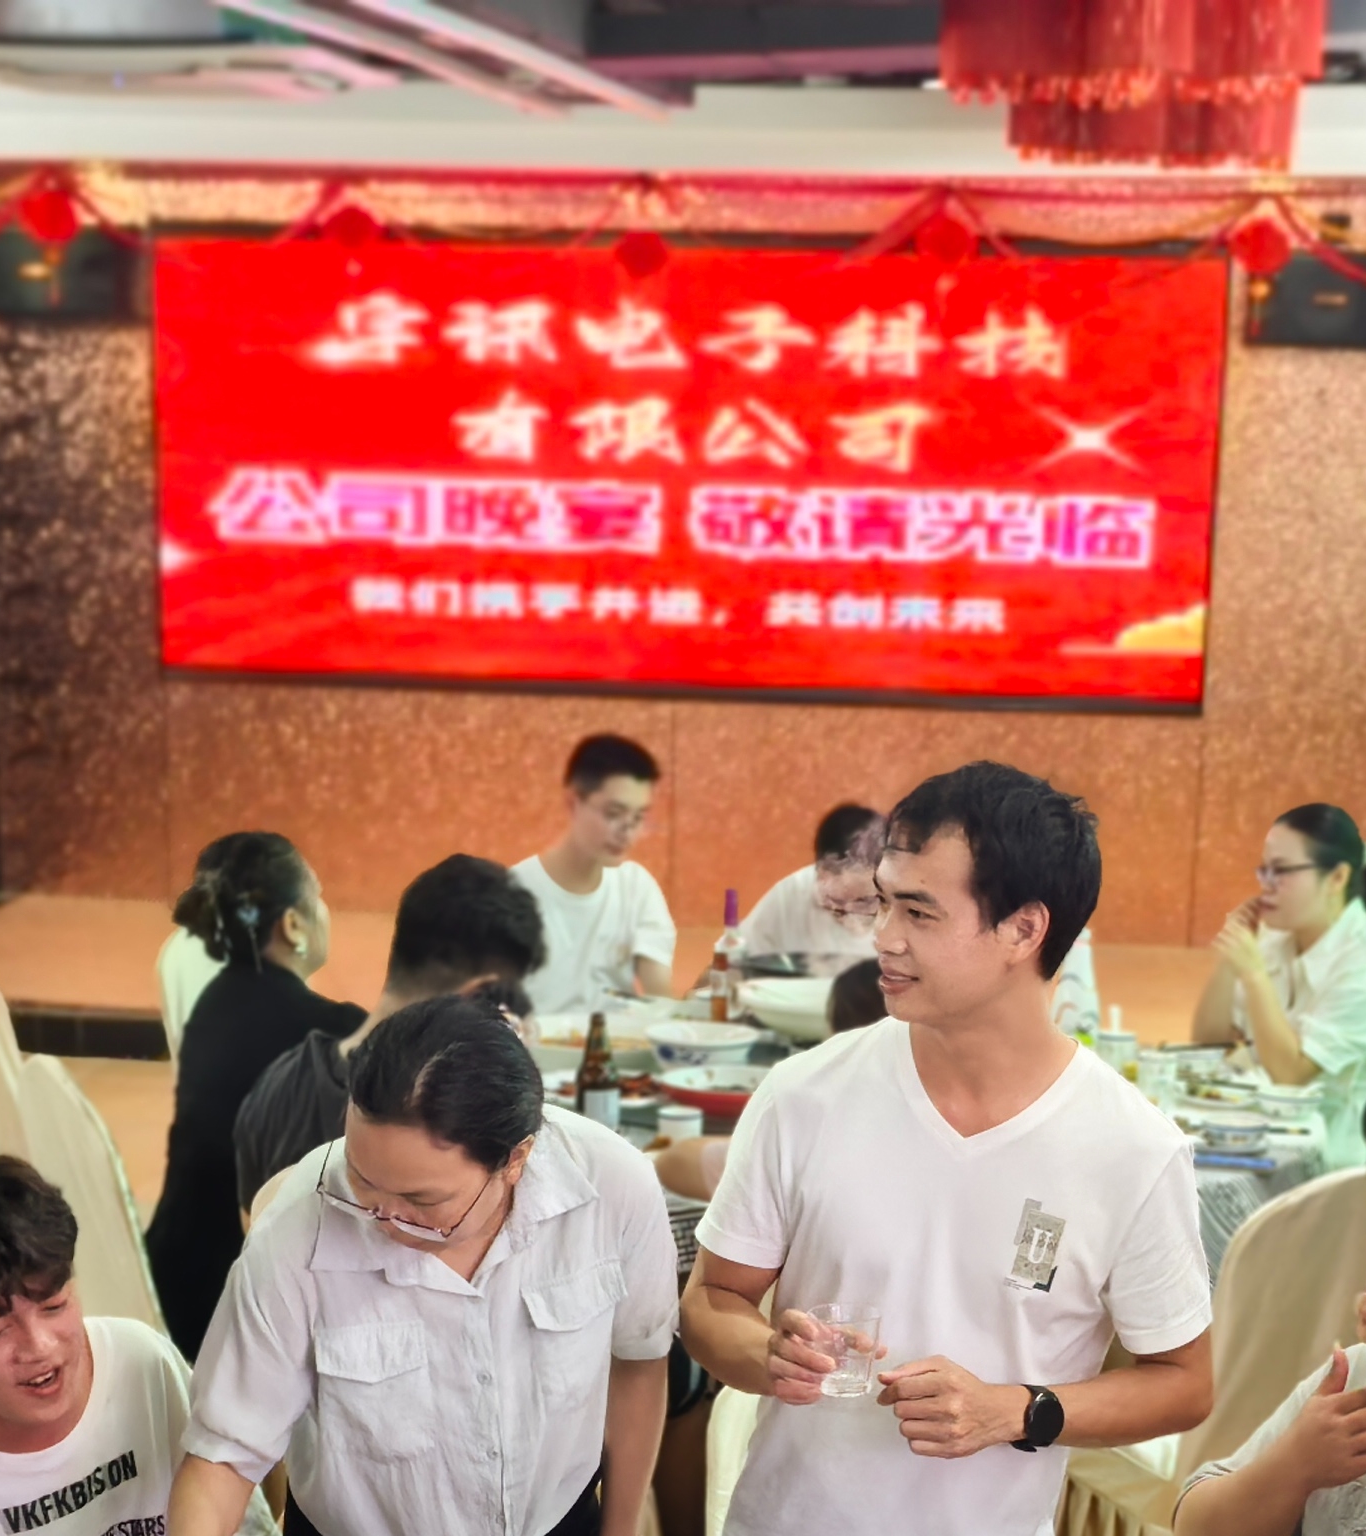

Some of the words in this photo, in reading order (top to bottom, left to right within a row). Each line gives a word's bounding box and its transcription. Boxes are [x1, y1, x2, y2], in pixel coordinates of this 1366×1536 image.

[451, 388, 933, 474] 有限公司
[207, 469, 663, 556] 公司晚宴
[688, 484, 1156, 569] 敬请光临
